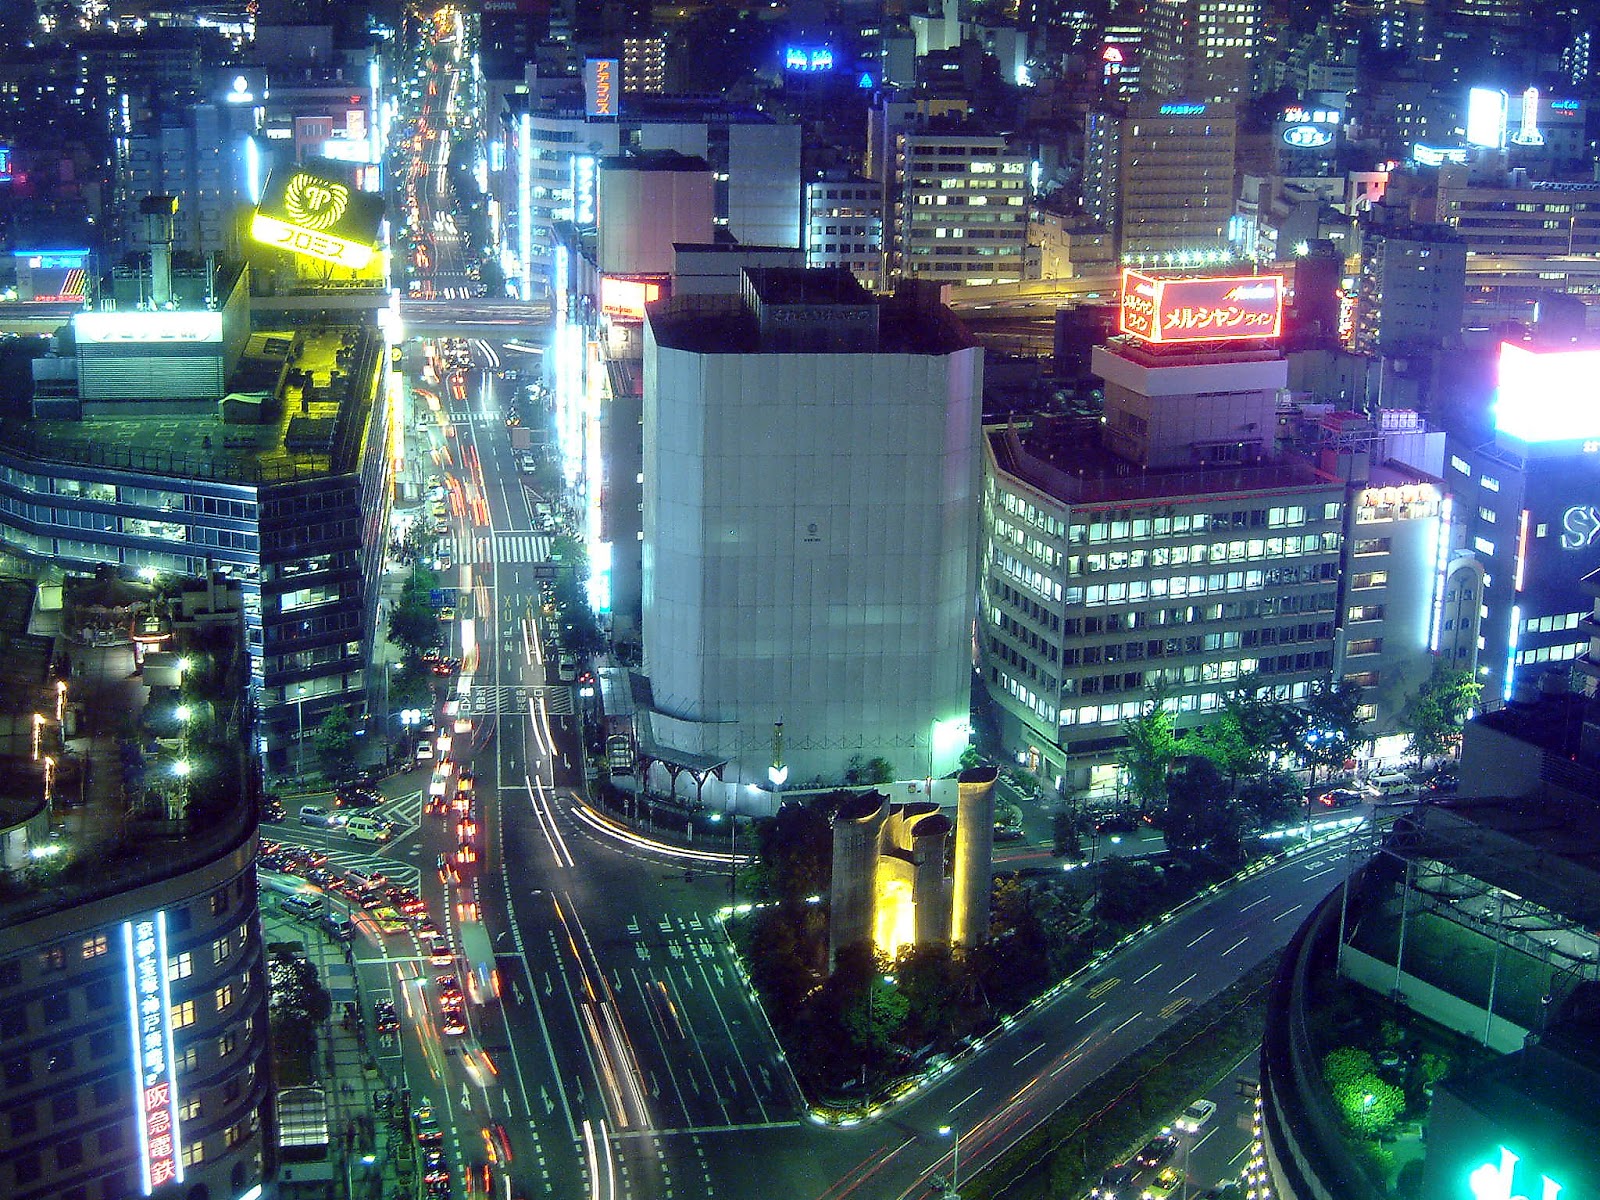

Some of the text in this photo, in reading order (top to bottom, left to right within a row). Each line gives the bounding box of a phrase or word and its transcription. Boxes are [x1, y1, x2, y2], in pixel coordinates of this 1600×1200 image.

[596, 61, 611, 115] アデランス
[277, 228, 344, 258] プロミス
[144, 1082, 177, 1187] 阪急電鉄
